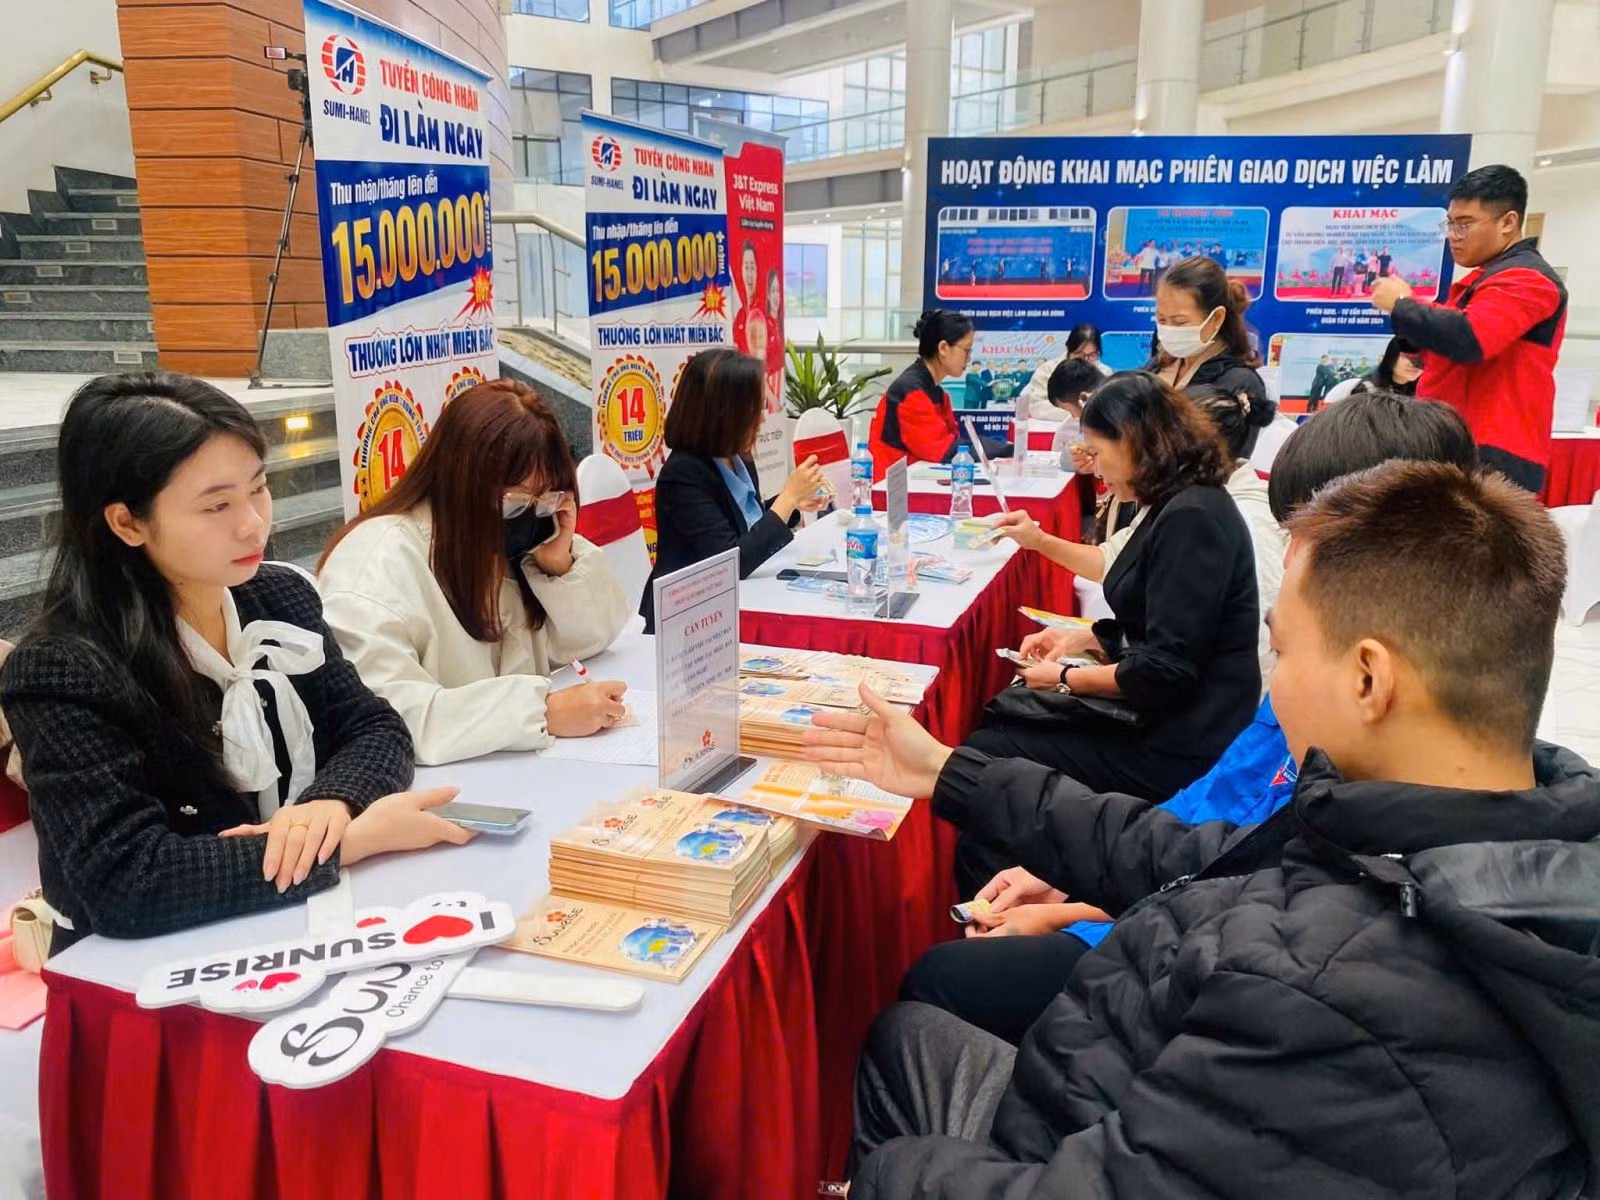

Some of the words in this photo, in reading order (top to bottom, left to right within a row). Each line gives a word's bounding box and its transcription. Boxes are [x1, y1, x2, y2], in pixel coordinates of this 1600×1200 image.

[380, 59, 418, 94] TUYỂN
[422, 73, 452, 104] CÔNG
[455, 83, 479, 112] NHÂN
[323, 99, 371, 125] SUMI-HANEL
[380, 104, 399, 144] ĐI
[404, 101, 440, 152] LÀM
[444, 121, 483, 159] NGAY
[666, 154, 690, 173] CÔNG
[693, 158, 715, 177] NHÂN
[941, 160, 994, 189] HOẠT
[999, 155, 1055, 189] ĐỘNG
[1061, 160, 1110, 184] KHAI
[1116, 159, 1163, 189] MẠC
[1170, 155, 1233, 184] PHIÊN
[1239, 159, 1288, 184] GIAO
[1294, 159, 1345, 189] DỊCH
[1352, 154, 1400, 189] VIỆC
[1404, 154, 1453, 184] LÀM
[331, 182, 352, 205] Thu
[407, 174, 422, 196] lên
[591, 175, 624, 190] SUMI-HANEL
[632, 176, 648, 201] ĐI
[653, 172, 681, 205] LÀM
[685, 186, 717, 210] NGAY
[749, 176, 778, 196] Express
[756, 196, 775, 213] Nam
[1333, 209, 1366, 219] KHAI
[617, 387, 646, 426] 14
[378, 428, 407, 491] 14
[480, 911, 495, 930] I
[167, 931, 397, 990] SUNRISE
[386, 973, 433, 1017] Chance
[425, 960, 444, 973] to
